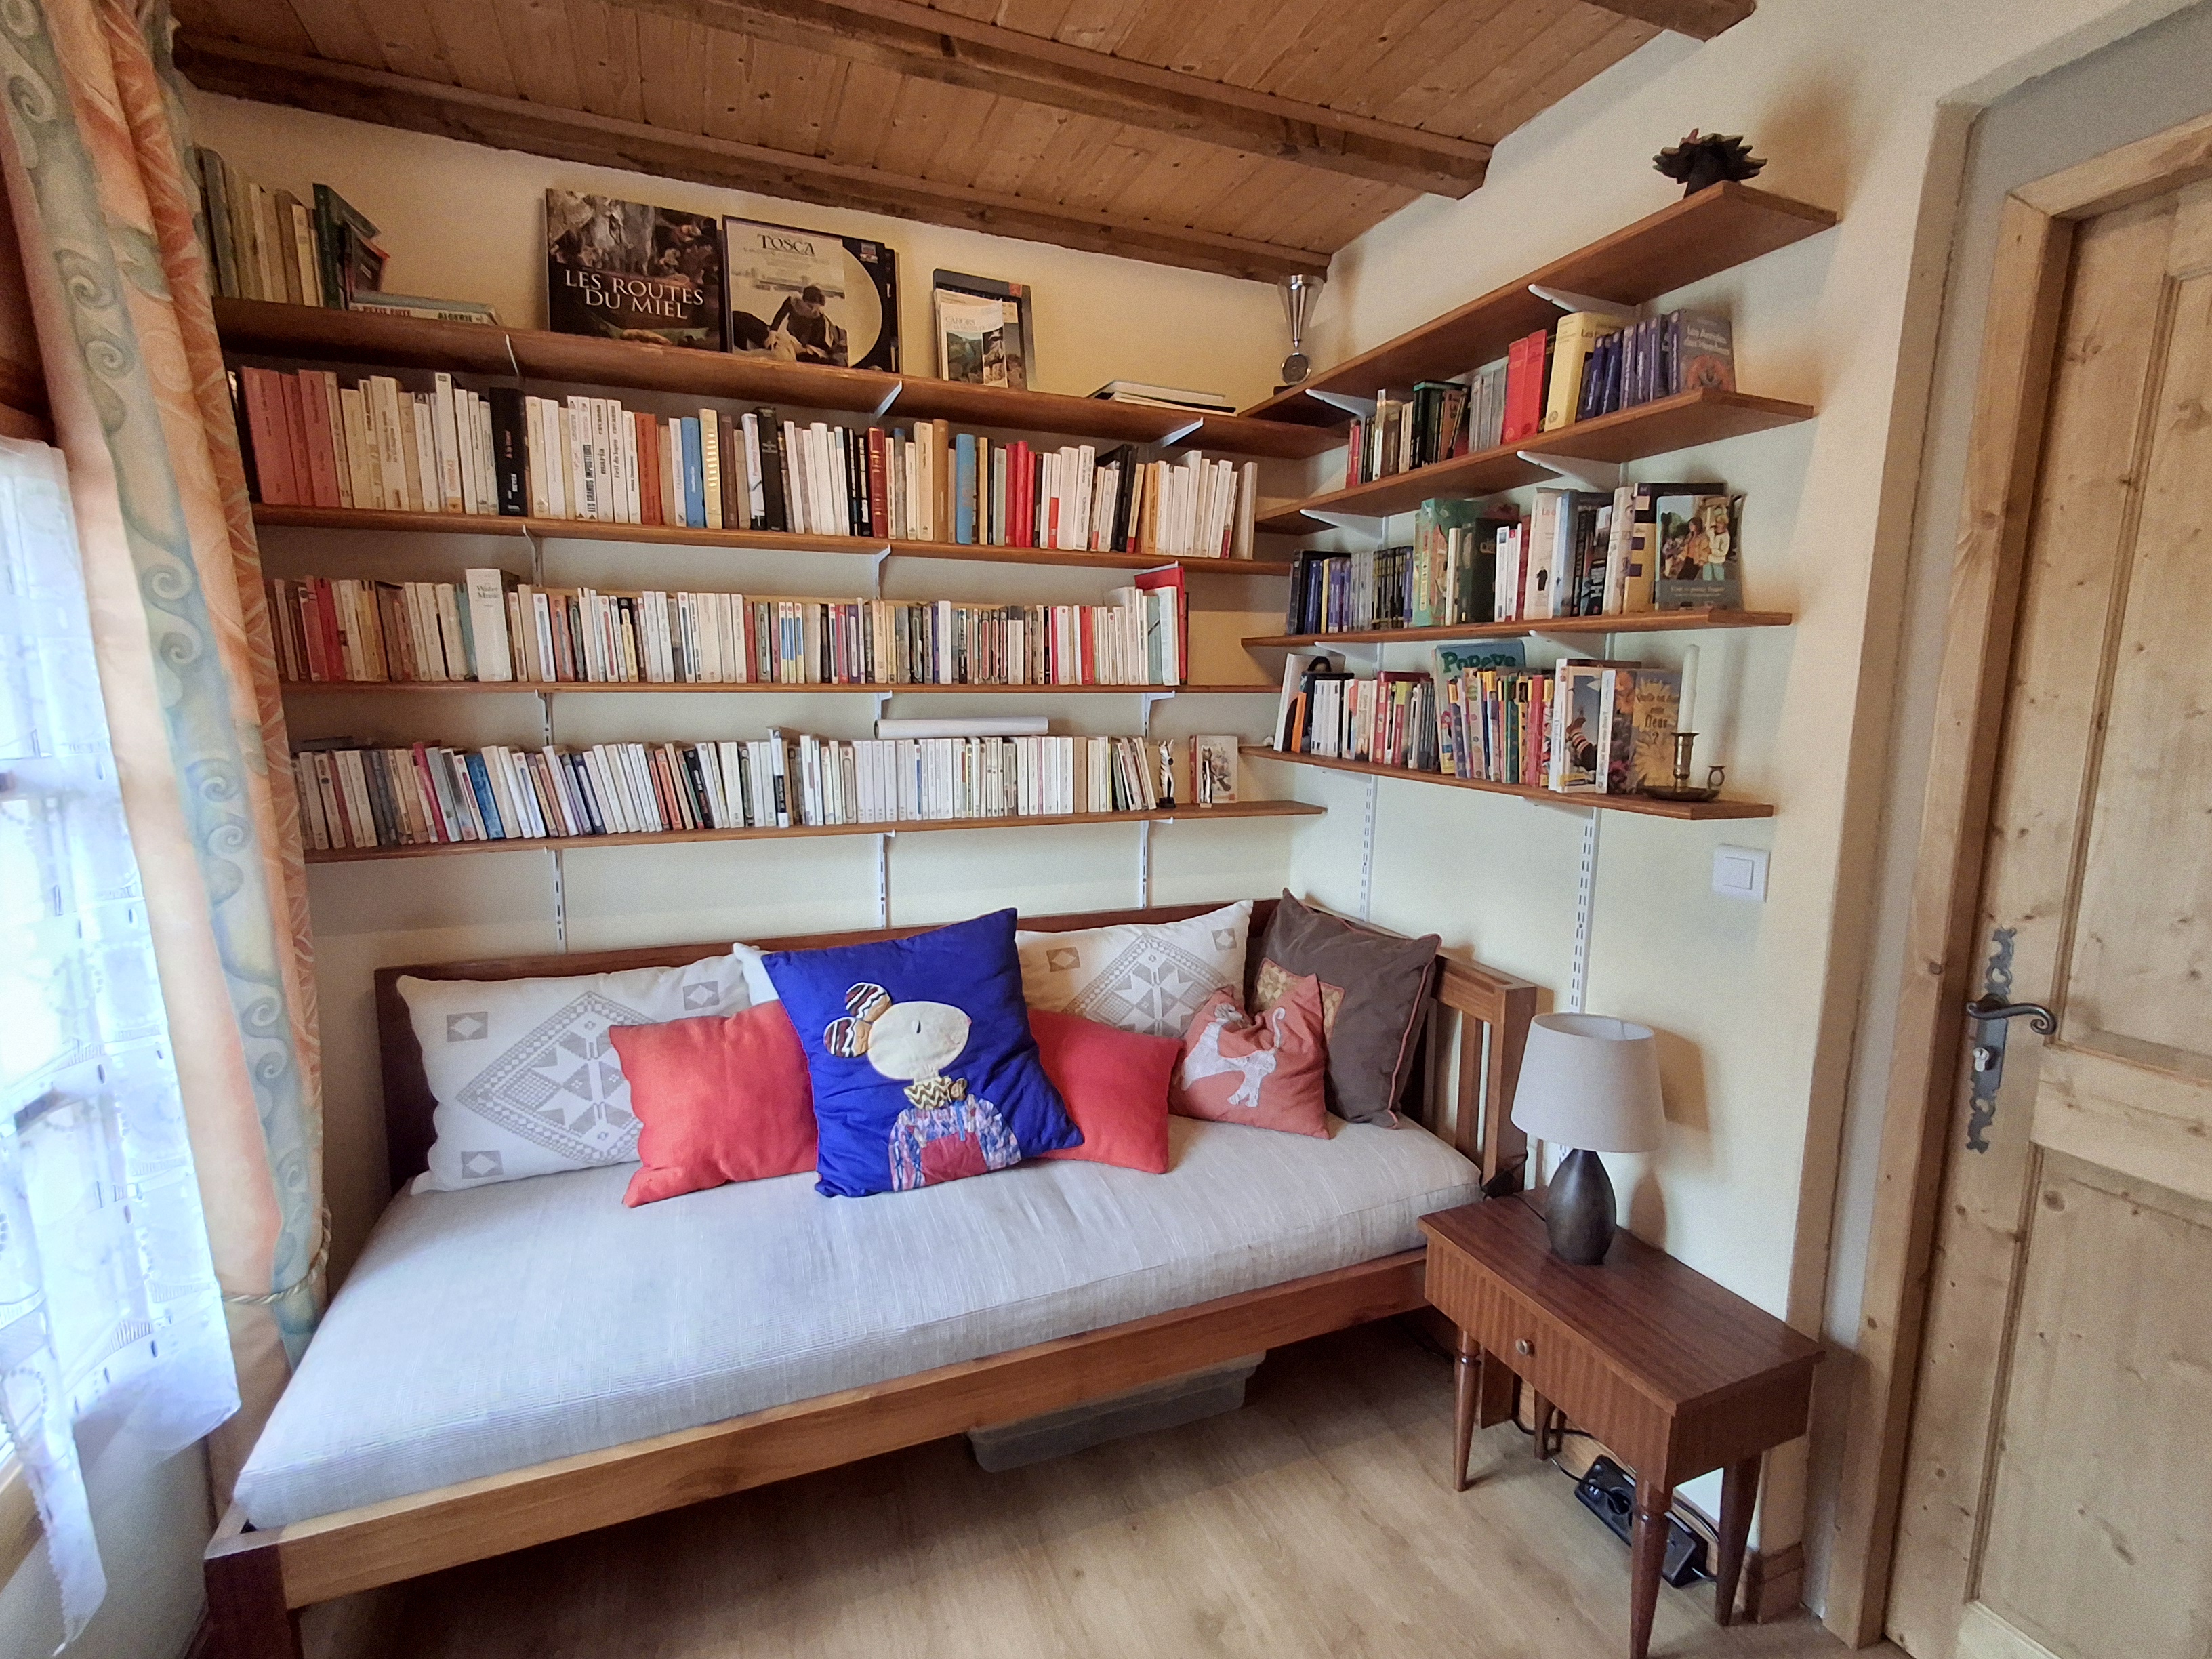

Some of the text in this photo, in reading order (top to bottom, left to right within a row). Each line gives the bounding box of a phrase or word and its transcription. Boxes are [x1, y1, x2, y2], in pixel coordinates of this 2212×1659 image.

[757, 234, 815, 256] TOSCA
[565, 269, 704, 306] LES ROUTES
[586, 289, 688, 320] DU MIEL
